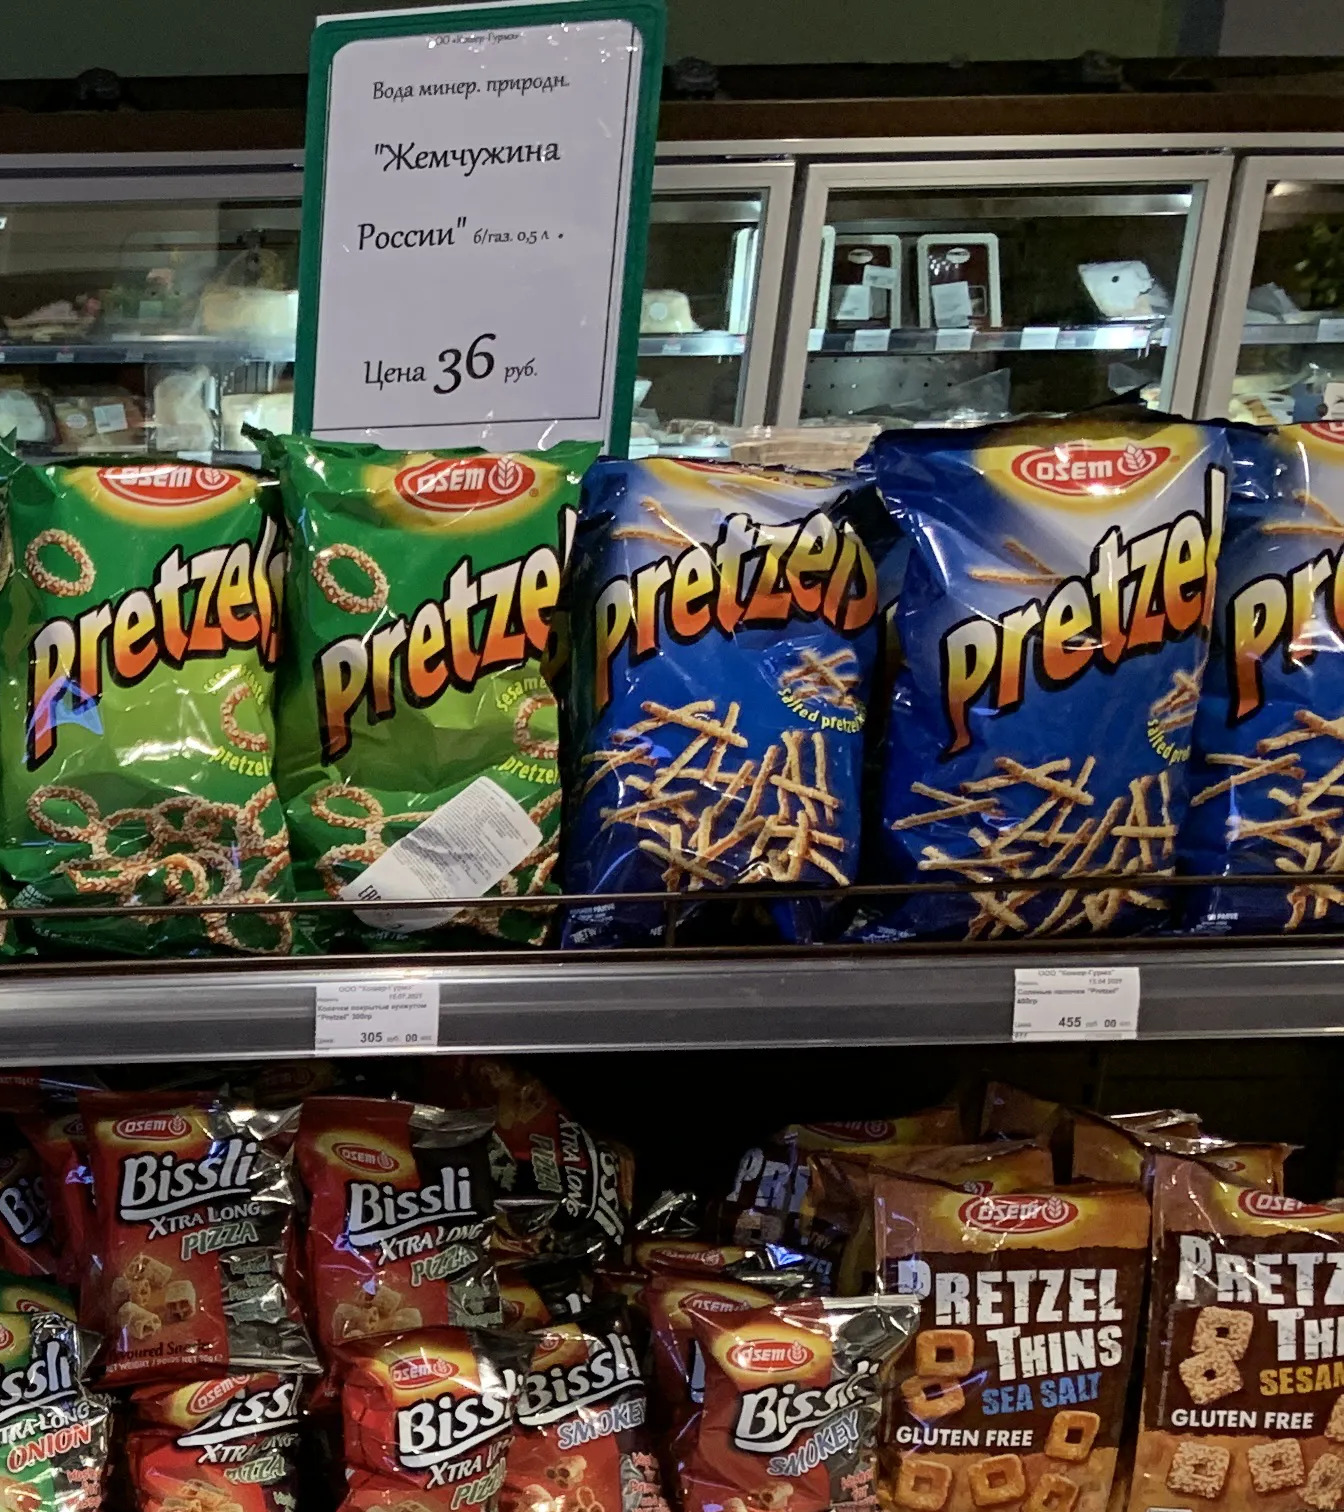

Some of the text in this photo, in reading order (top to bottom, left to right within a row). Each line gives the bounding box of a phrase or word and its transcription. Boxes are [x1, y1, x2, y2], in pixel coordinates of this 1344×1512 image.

[372, 73, 570, 102] Вода минер. природн.
[374, 142, 561, 176] "Жемчужина
[357, 217, 467, 252] России"
[364, 332, 538, 395] Цена 36 руб.
[416, 464, 485, 494] OSEM
[1036, 459, 1114, 482] OSEM
[360, 1032, 382, 1043] 305
[1058, 1017, 1081, 1028] 455
[122, 1138, 256, 1207] Bissli
[207, 1201, 261, 1225] LONG
[181, 1222, 258, 1261] PIZZA
[897, 1260, 1123, 1326] PRETZEL
[986, 1326, 1122, 1381] THINS
[982, 1372, 1102, 1416] SEA SALT
[556, 1397, 647, 1450] SMOKEY
[1172, 1408, 1313, 1430] GLUTEN FREE
[896, 1426, 1034, 1448] GLUTEN FREE
